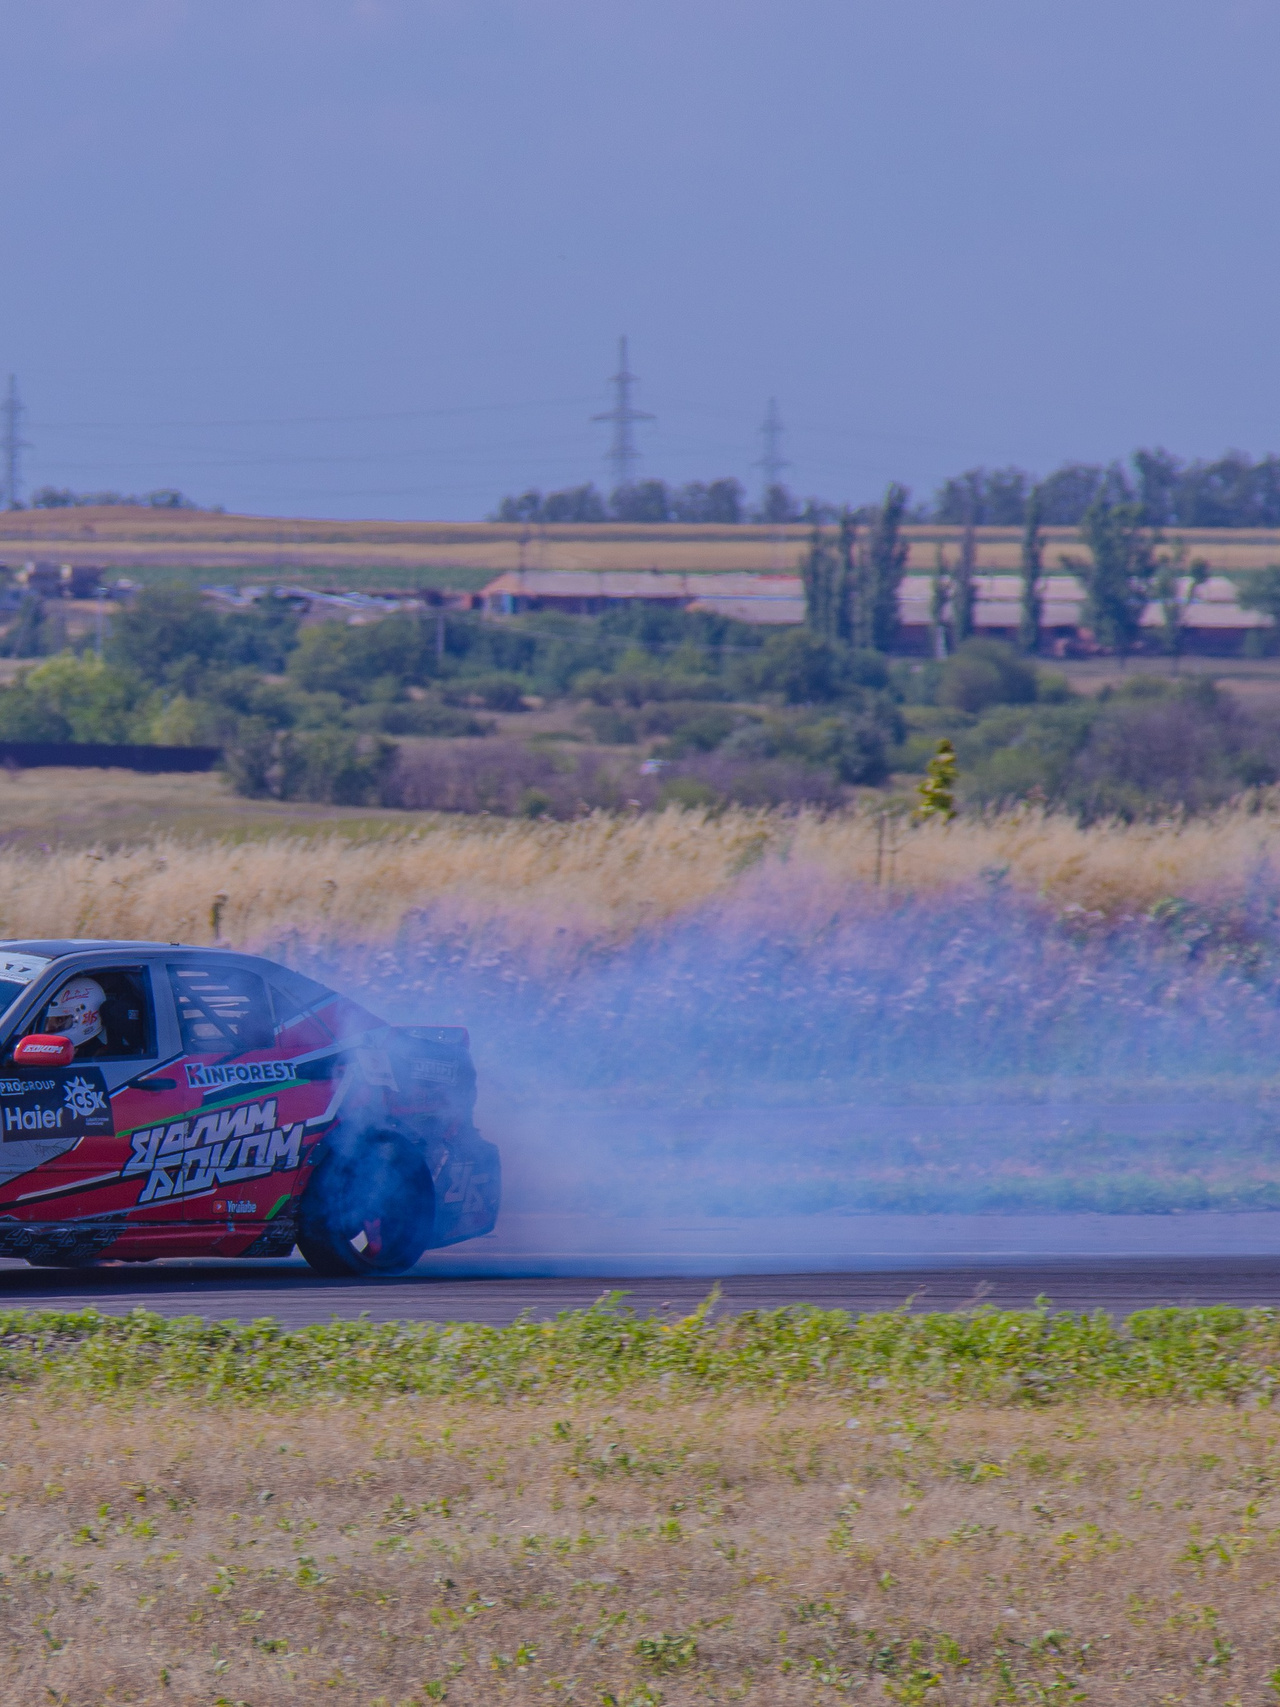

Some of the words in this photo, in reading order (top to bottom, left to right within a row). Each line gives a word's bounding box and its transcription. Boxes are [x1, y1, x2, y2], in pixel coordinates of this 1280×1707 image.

[185, 1062, 295, 1087] KINFOREST
[73, 1091, 108, 1110] CSK
[4, 1104, 63, 1131] Haier
[227, 1200, 257, 1213] YouTube
